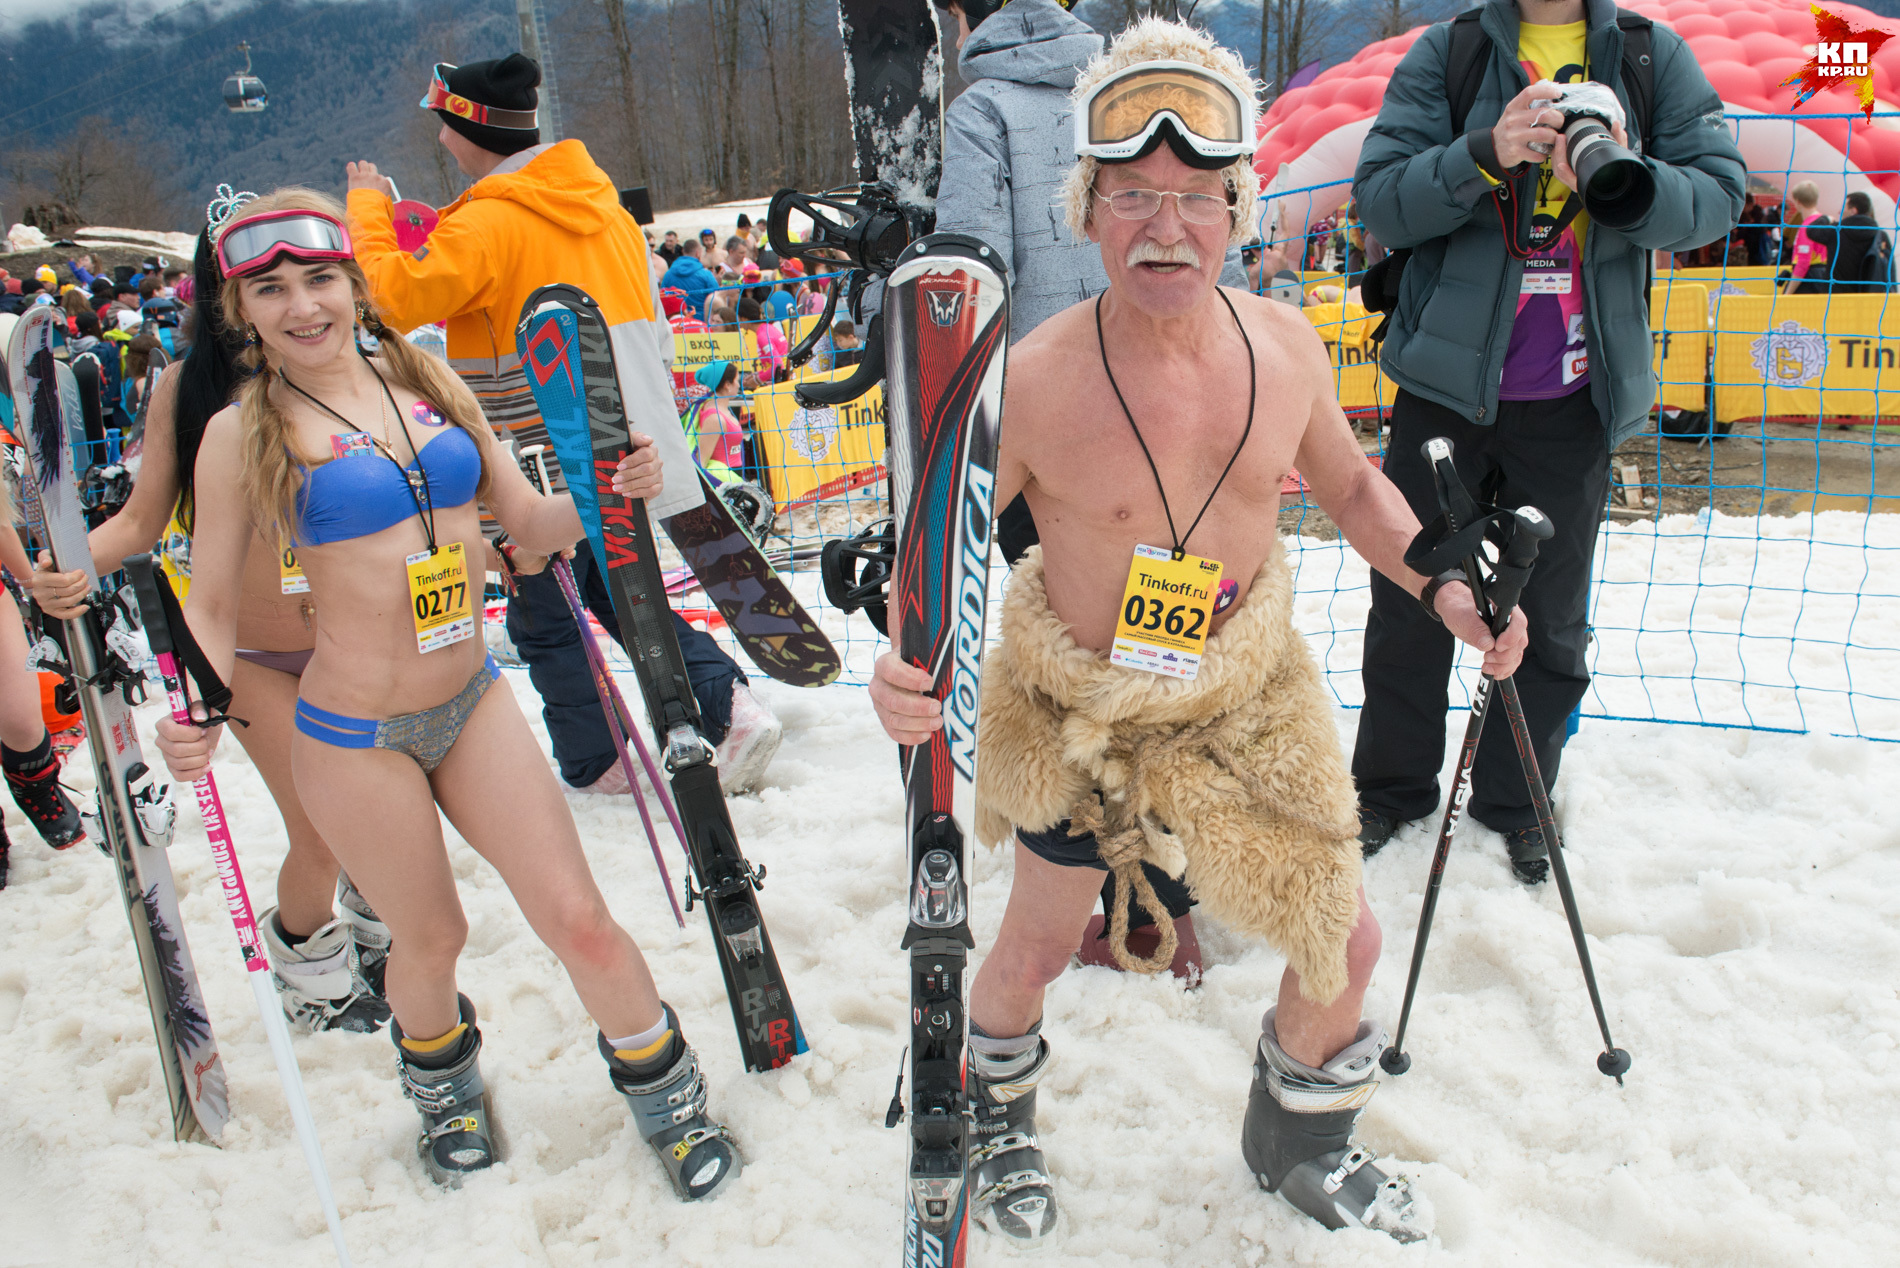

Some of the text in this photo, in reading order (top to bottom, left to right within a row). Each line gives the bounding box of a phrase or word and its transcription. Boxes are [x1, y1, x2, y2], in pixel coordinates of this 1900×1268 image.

[1526, 259, 1556, 268] MEDIA
[690, 340, 720, 350] ВХОД
[415, 567, 462, 586] Tinkoff.ru
[1139, 573, 1208, 600] Tinkoff.ru
[415, 581, 466, 620] 0277
[944, 460, 995, 782] NORDICA
[1124, 595, 1206, 640] 0362
[650, 1067, 685, 1091] SALOMON
